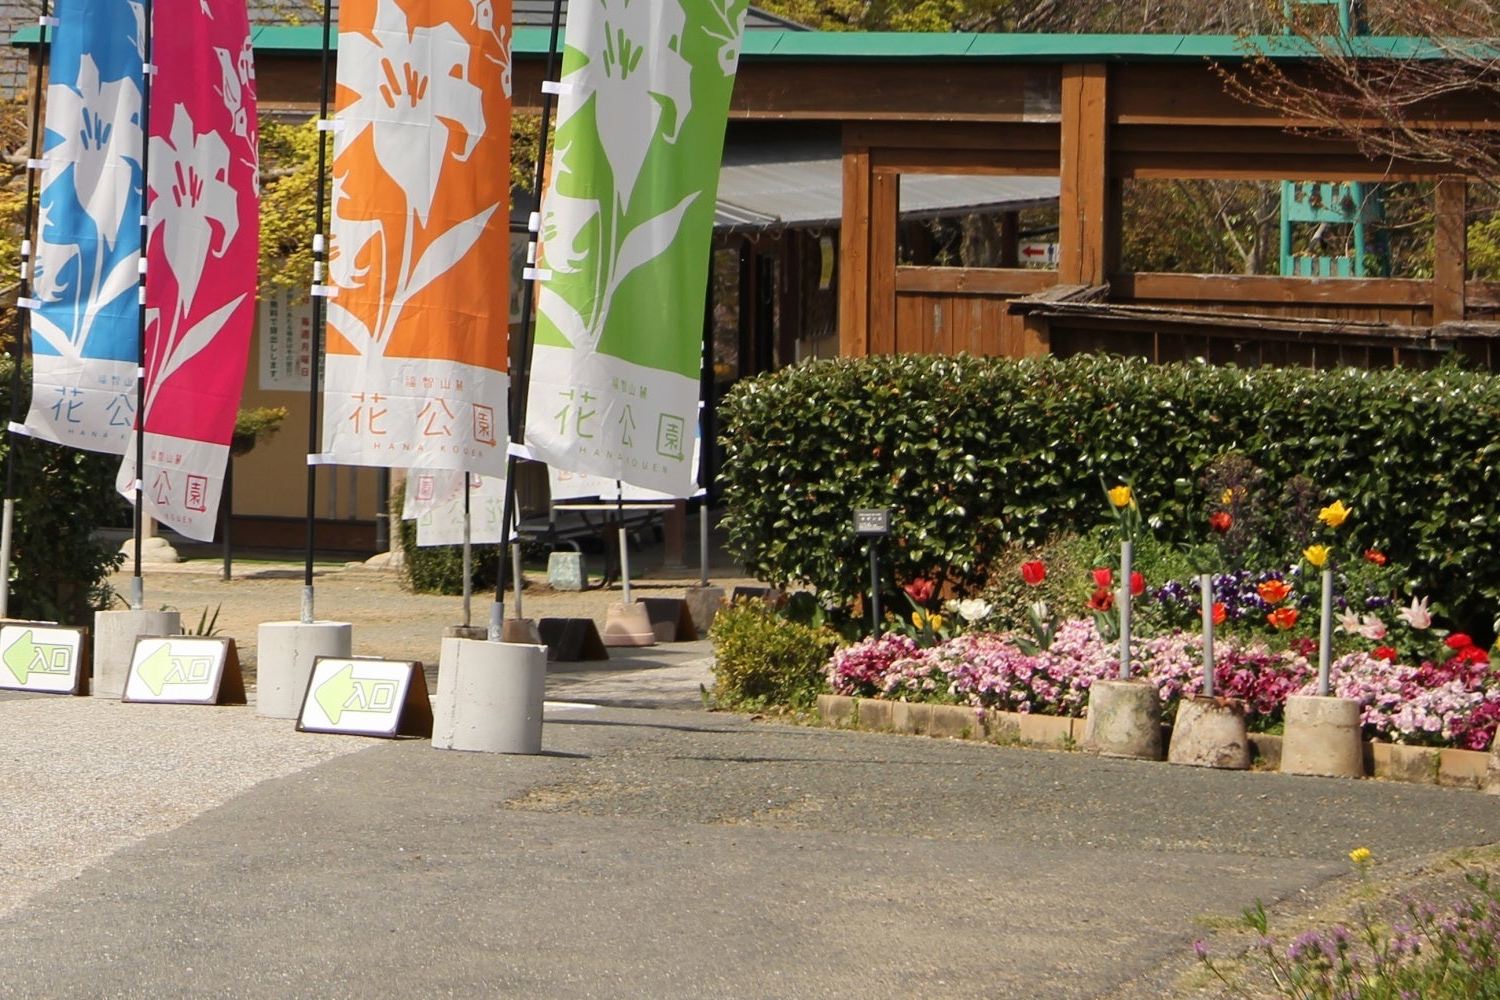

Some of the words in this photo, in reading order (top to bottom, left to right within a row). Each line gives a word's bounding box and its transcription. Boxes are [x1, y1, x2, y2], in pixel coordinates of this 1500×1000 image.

[349, 392, 497, 447] 花公園
[554, 389, 685, 462] 花公園
[67, 428, 109, 440] HANA
[373, 442, 425, 452] HANA
[440, 445, 484, 459] KOUEN
[578, 446, 622, 463] HANA
[27, 646, 72, 672] 入口
[164, 658, 212, 683] 入口
[342, 681, 396, 710] 入口
